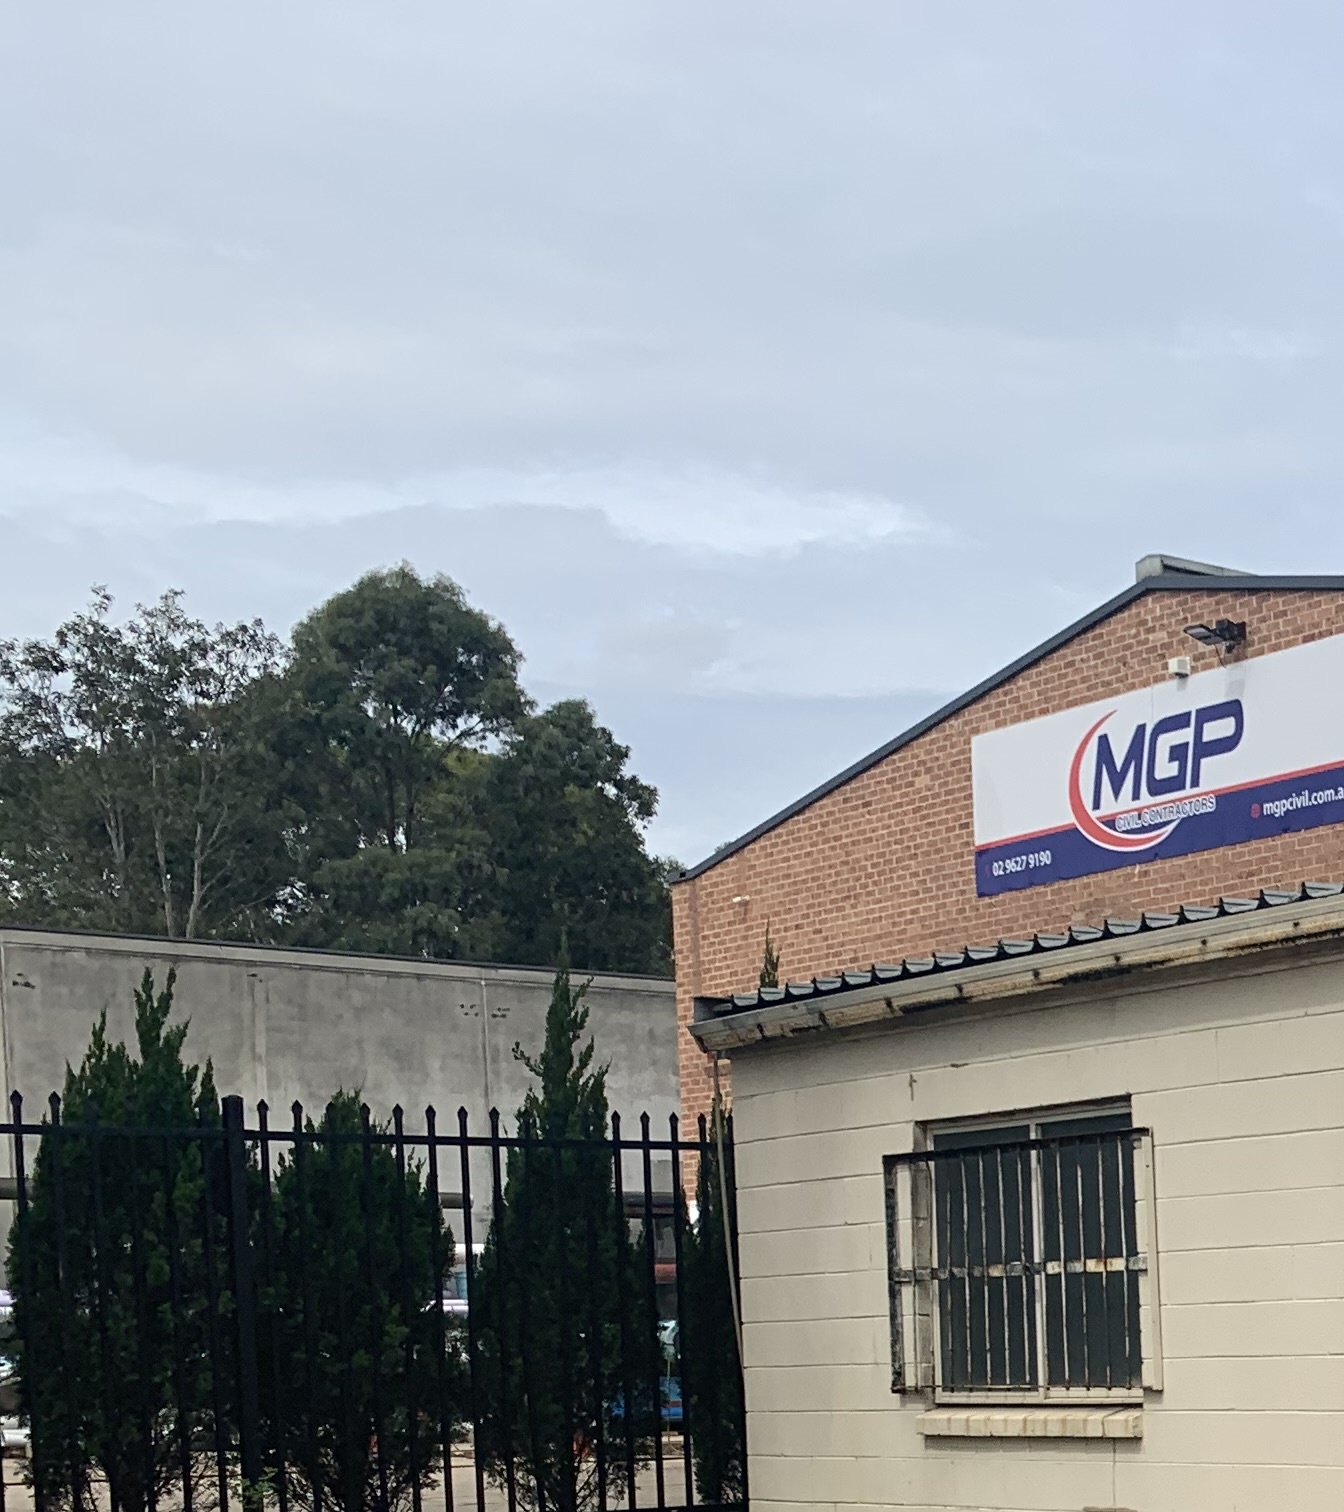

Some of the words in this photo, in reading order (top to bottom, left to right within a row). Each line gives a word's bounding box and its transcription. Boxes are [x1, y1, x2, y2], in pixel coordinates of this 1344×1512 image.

[1092, 698, 1244, 811] MGP
[1115, 811, 1141, 832] CIVIL
[1141, 794, 1216, 826] CONTRACTORS
[992, 860, 1005, 877] 02
[1005, 855, 1027, 874] 9627
[1028, 849, 1052, 869] 9190
